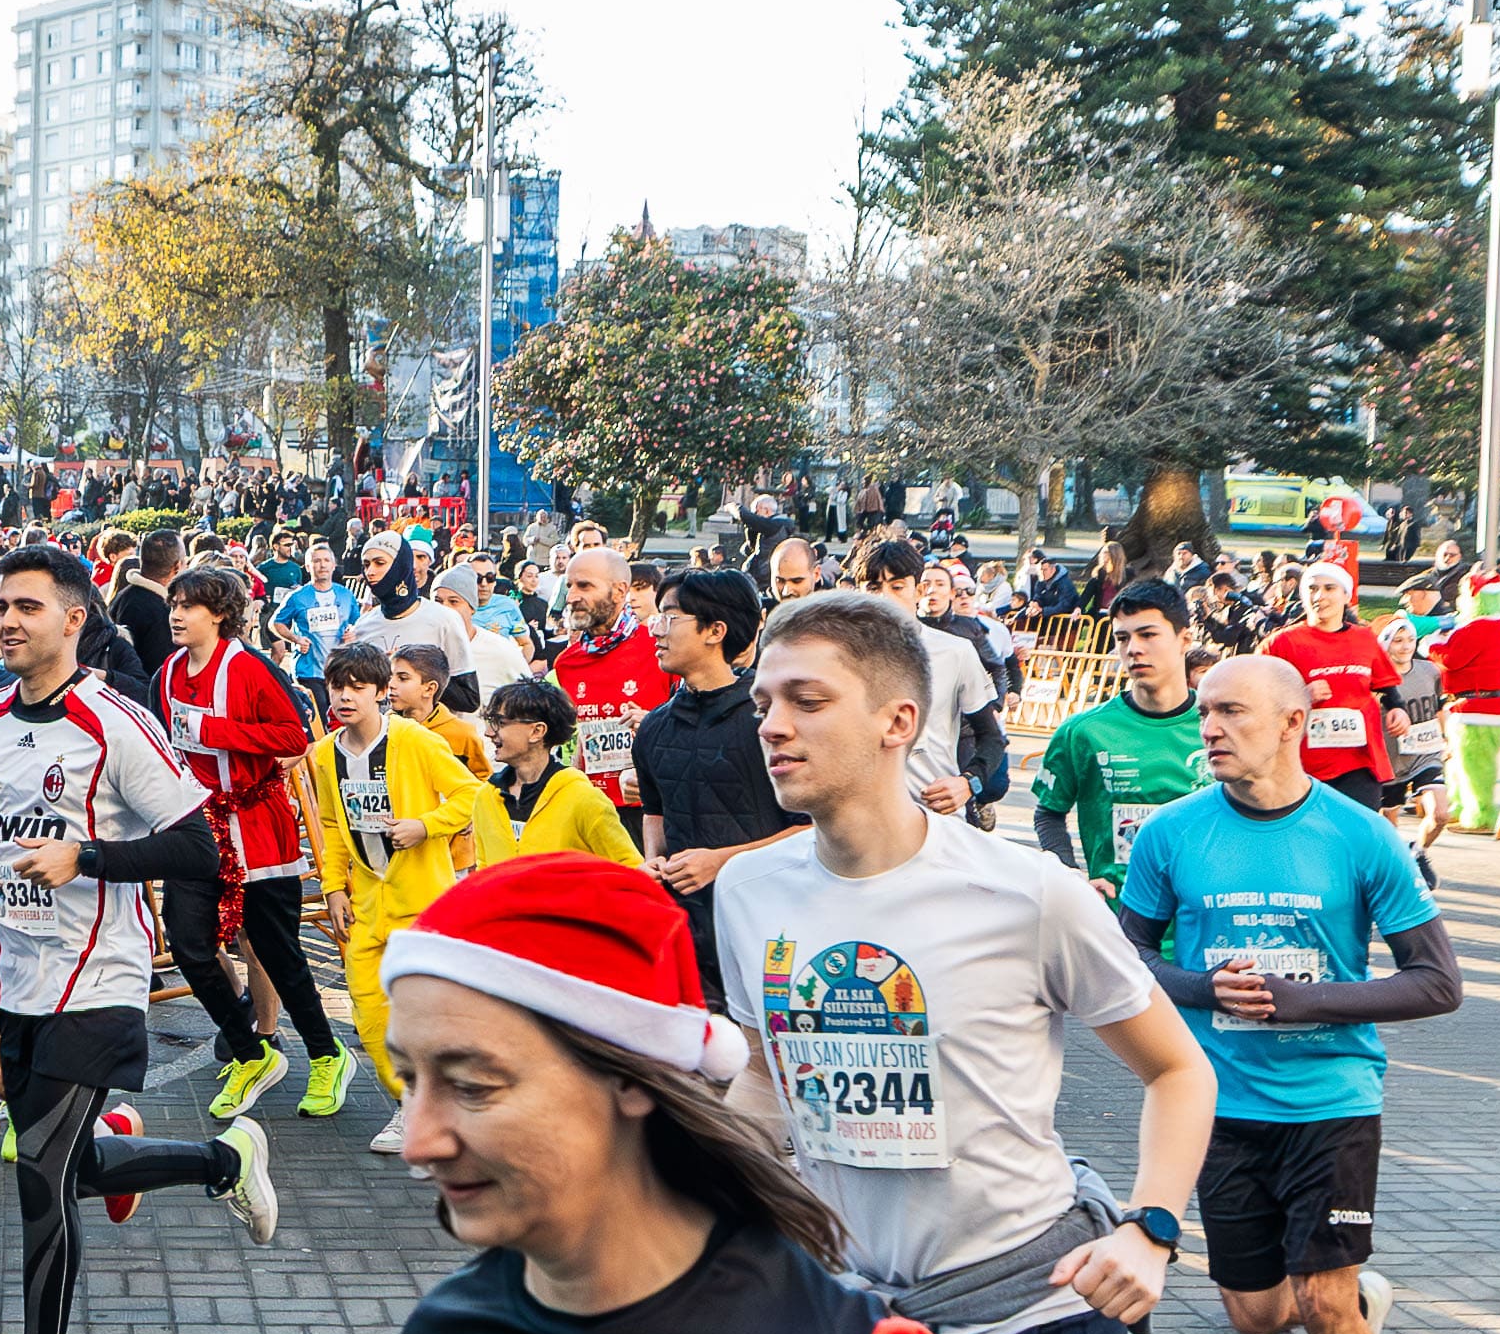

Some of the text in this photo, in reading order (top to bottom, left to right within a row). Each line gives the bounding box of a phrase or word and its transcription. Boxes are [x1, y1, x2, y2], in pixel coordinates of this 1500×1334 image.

[577, 704, 598, 716] OPEN
[599, 732, 631, 751] 2063
[362, 795, 391, 813] 424
[7, 882, 54, 908] 3343
[1268, 892, 1323, 910] NOCTURNA
[1257, 953, 1314, 971] SILVESTRE
[834, 988, 874, 1001] XL SAN
[823, 1002, 886, 1015] SILVESTRE
[785, 1040, 929, 1068] XLII SAN SILVESTRE
[833, 1071, 934, 1115] 2344
[836, 1120, 937, 1140] PONTEVEDRA 2025
